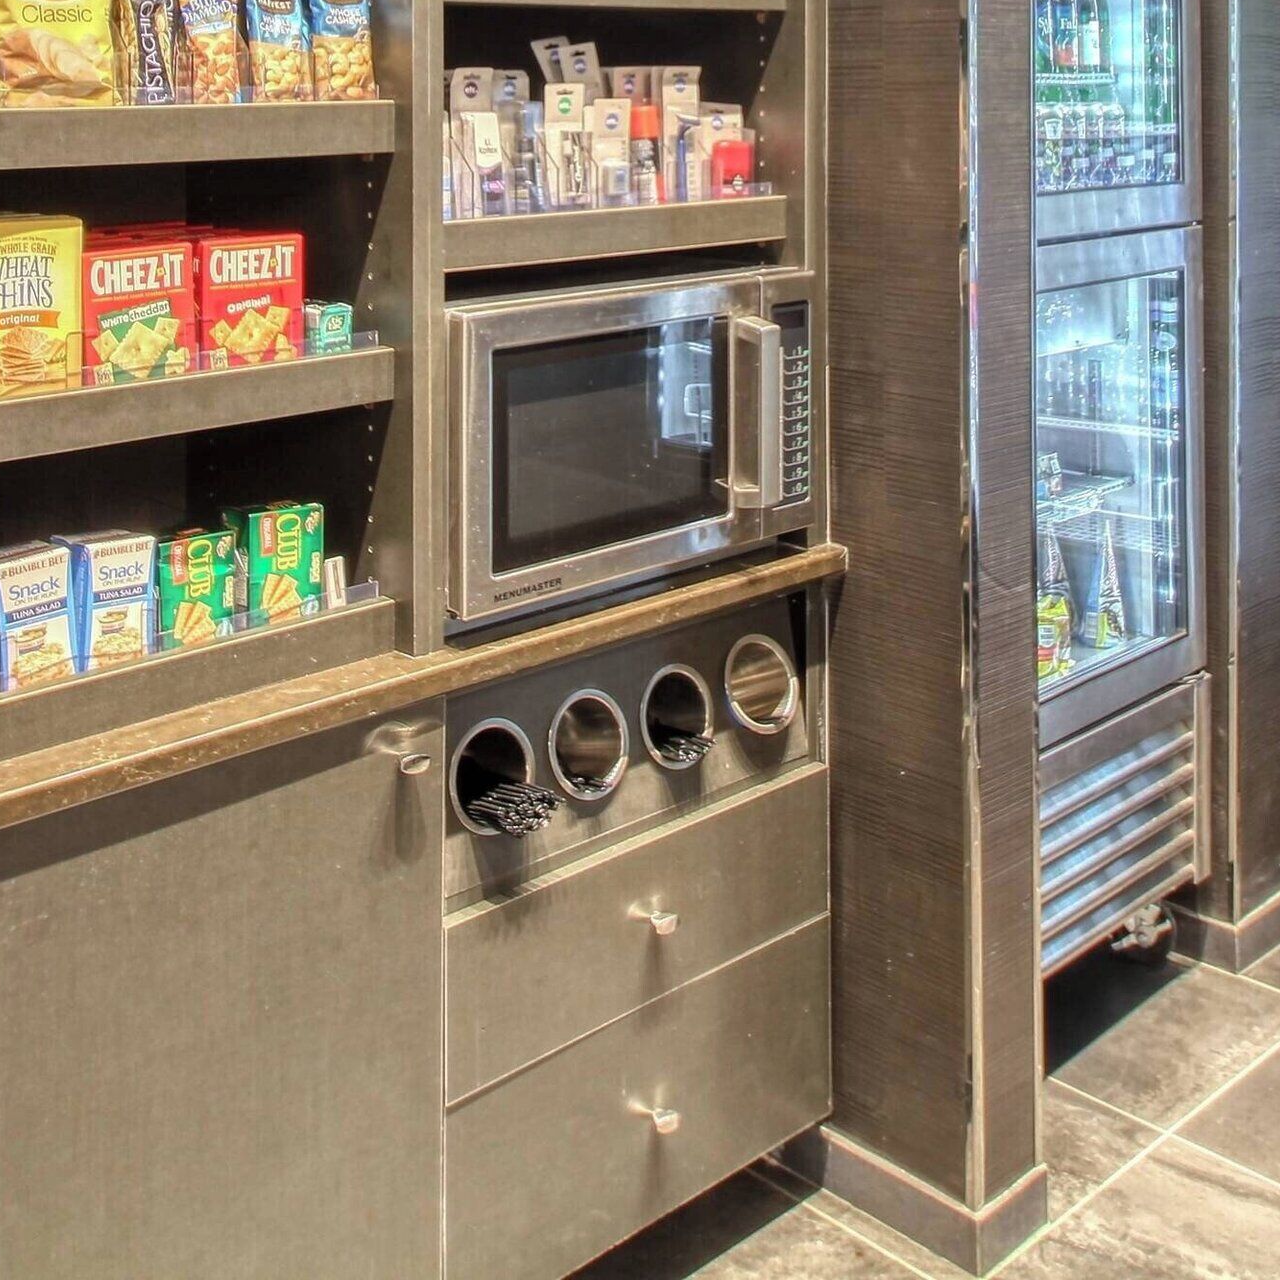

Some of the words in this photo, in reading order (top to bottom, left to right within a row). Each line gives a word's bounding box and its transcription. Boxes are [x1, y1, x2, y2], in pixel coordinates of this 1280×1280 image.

[21, 4, 93, 24] Classic
[182, 0, 233, 24] DIAMOND
[325, 15, 368, 25] CASHEWS
[329, 7, 361, 17] WHOLE
[0, 242, 29, 256] WHOLE
[30, 242, 57, 256] GRAIN
[127, 299, 171, 323] cheddar
[226, 294, 272, 315] ORIGINAL
[0, 313, 41, 327] original
[99, 544, 133, 559] BUMBLE
[133, 541, 151, 553] BEE
[275, 513, 302, 570] CLUB
[8, 560, 46, 578] BUMBLE
[47, 555, 66, 568] BEE
[98, 561, 145, 583] Snack
[186, 539, 213, 598] CLUB
[8, 575, 61, 603] Snack
[98, 590, 120, 601] TUNA
[119, 586, 143, 598] SALAD
[493, 577, 562, 603] MENUMASTER
[11, 608, 35, 621] TUNA
[35, 600, 62, 615] SALAD
